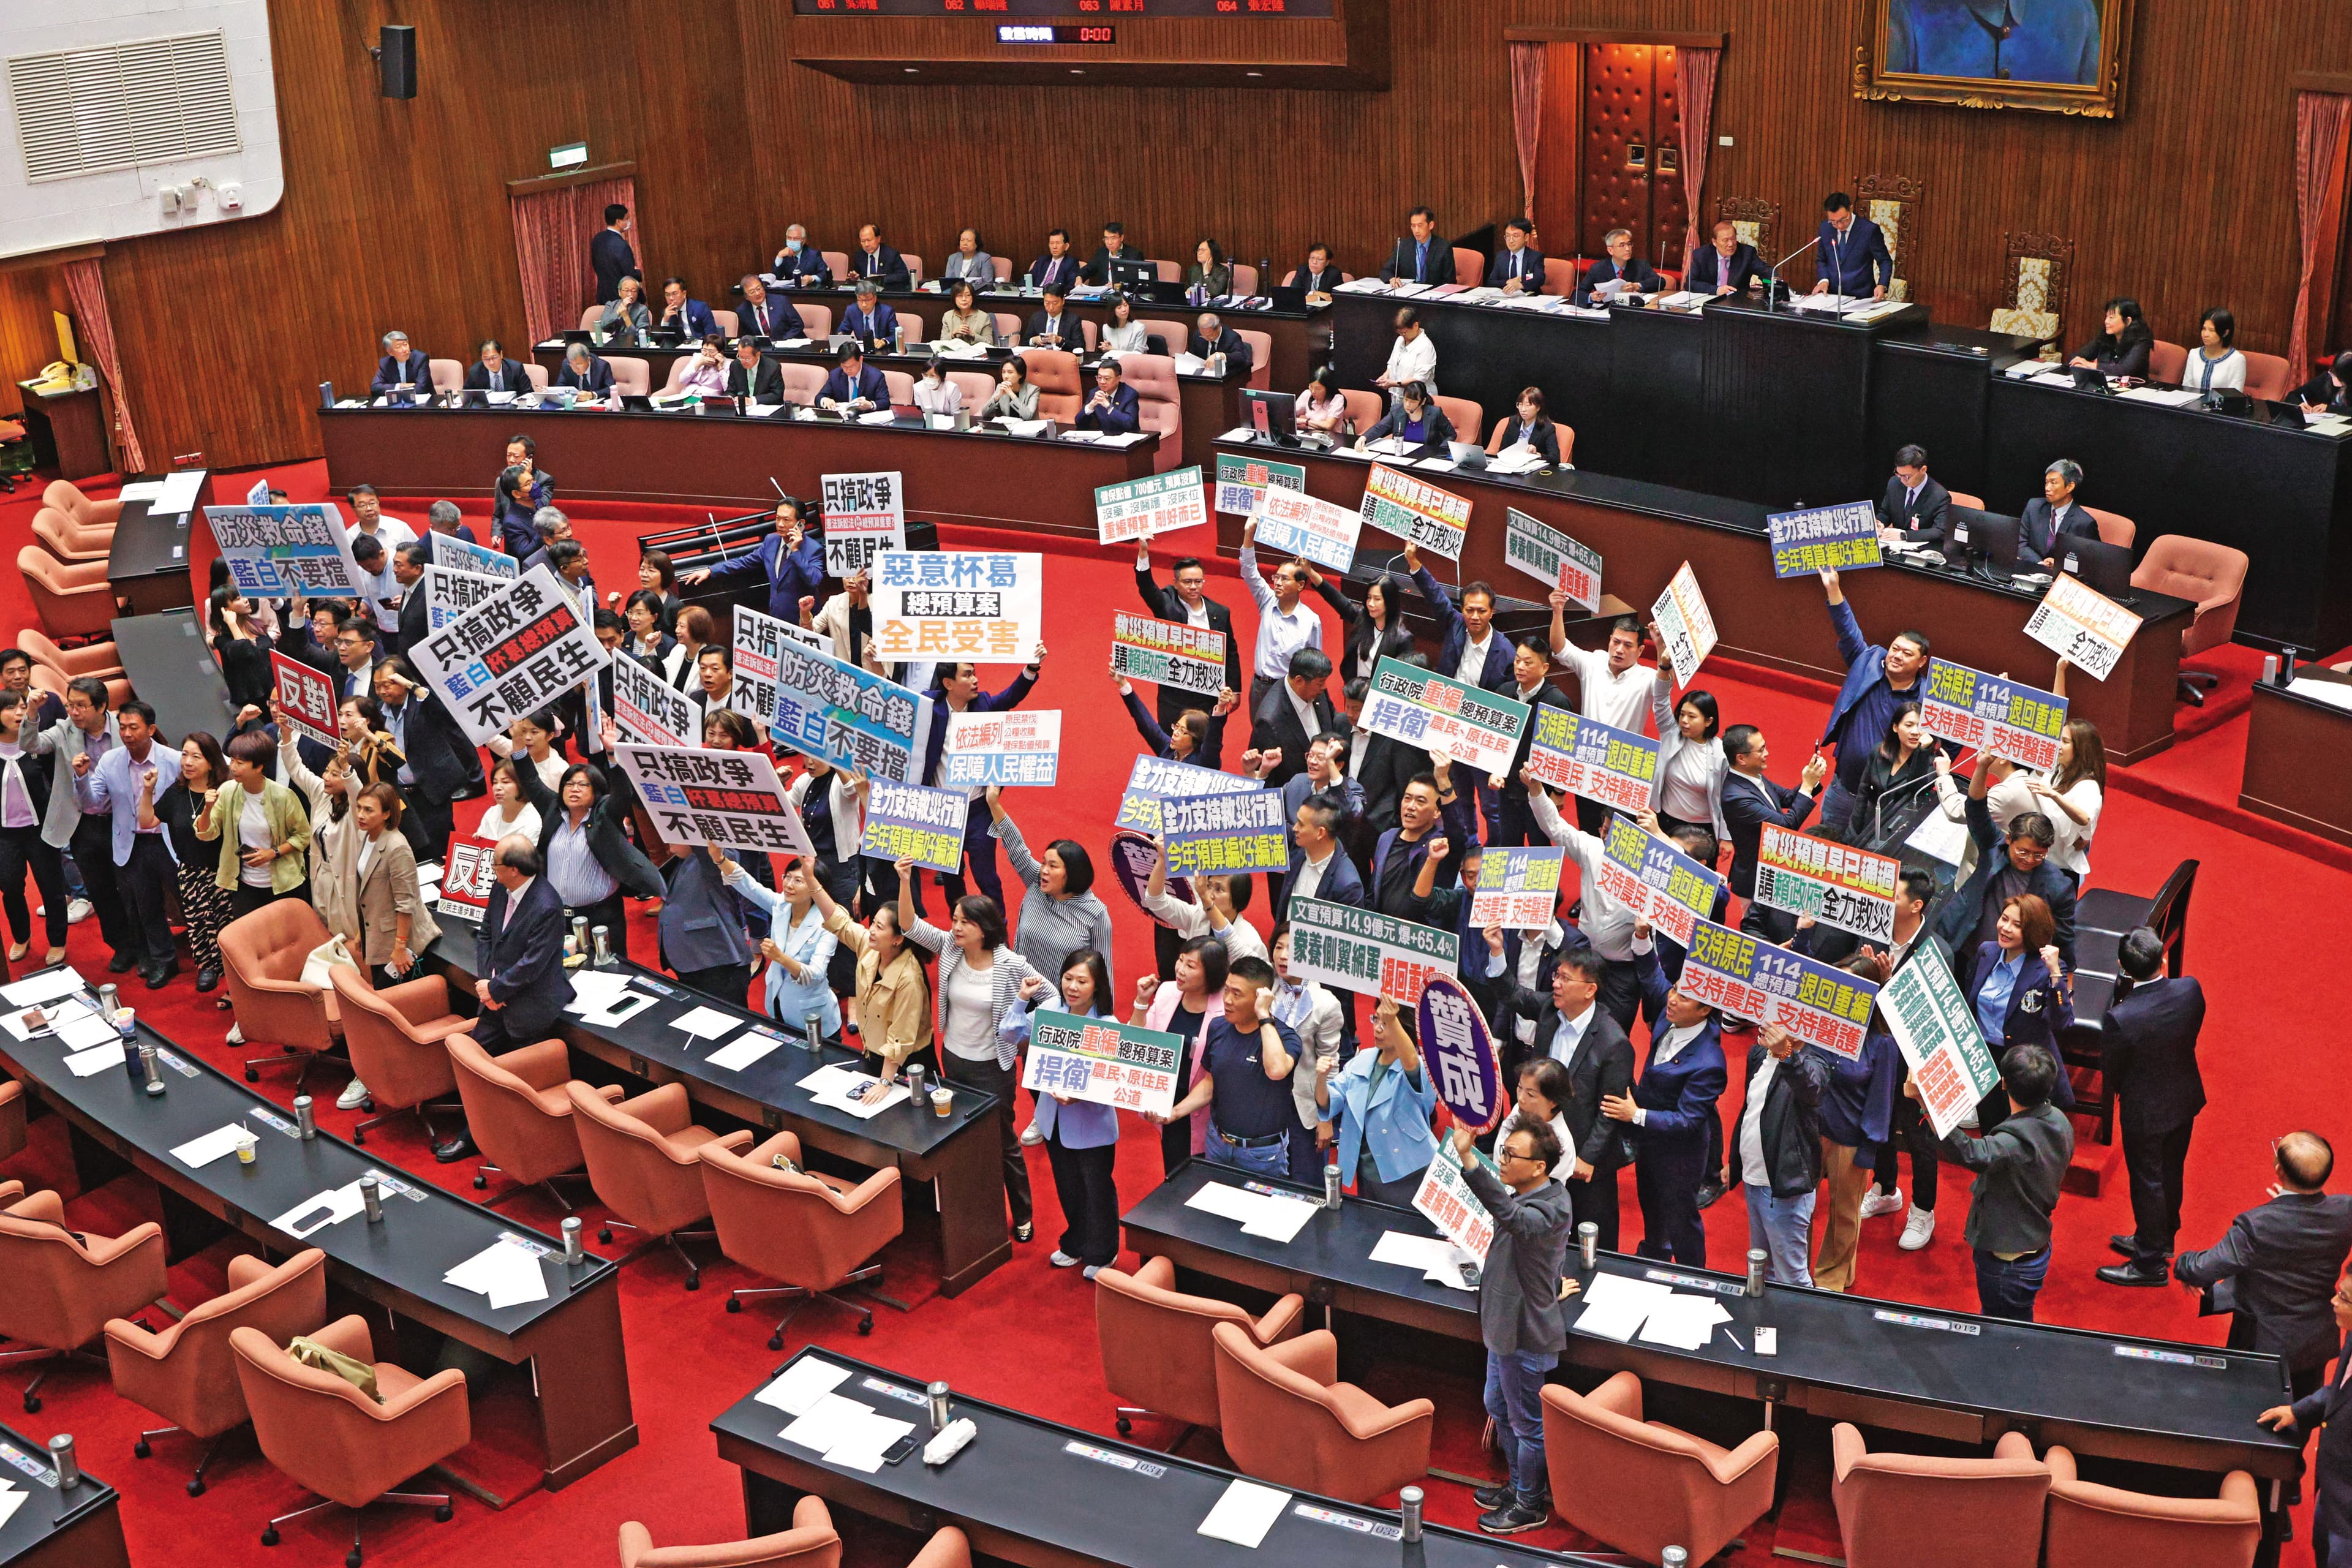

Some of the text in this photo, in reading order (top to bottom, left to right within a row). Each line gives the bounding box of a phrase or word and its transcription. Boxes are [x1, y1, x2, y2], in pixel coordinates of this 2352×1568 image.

[1080, 0, 1099, 11] 063
[1217, 0, 1237, 12] 064
[1080, 28, 1111, 42] 0:00
[825, 477, 892, 512] 只搞政爭
[1100, 470, 1198, 502] 健保點值 700億元 預算沒編
[1221, 487, 1254, 510] 捍衛
[1370, 466, 1470, 529] 救災預算早已通過
[1104, 503, 1202, 540] 重編預算 剛好而已
[1268, 496, 1312, 523] 依法編列
[1364, 494, 1463, 557] 請賴政府全力救災
[1770, 507, 1875, 543] 全力支持救災行動
[211, 514, 333, 548] 防災救命錢
[1258, 518, 1351, 570] 保障人民權益
[230, 557, 350, 589] 藍白不要擋
[883, 553, 1017, 588] 惡意杯葛
[1776, 538, 1880, 575] 今年預算編好編滿
[907, 592, 998, 616] 總預算案
[429, 580, 544, 672] 只搞政爭
[881, 620, 1019, 654] 全民受害
[1115, 613, 1223, 662] 救災預算早已通過
[467, 639, 598, 729] 不顧民生
[1115, 645, 1221, 692] 請賴政府全力救災
[277, 664, 331, 728] 反對
[615, 657, 690, 737] 只搞政爭
[735, 674, 776, 718] 不顧
[781, 647, 915, 738] 防災救命錢
[1379, 673, 1520, 734] 行政院重編總預算案
[1928, 662, 2064, 738] 支持原民 114 退回重編
[1973, 701, 2010, 722] 總預算
[956, 721, 1003, 750] 依法編列
[1005, 714, 1037, 724] 原民禁伐
[1370, 699, 1430, 737] 捍衛
[775, 697, 908, 781] 藍白不要擋
[1003, 740, 1052, 750] 健保點值預算
[1450, 742, 1479, 763] 公道
[1535, 709, 1657, 781] 支持原民 114 退回重編
[1576, 745, 1607, 766] 總預算
[1921, 704, 2057, 771] 支持農民 支持醫護
[631, 751, 754, 786] 只搞政爭
[949, 755, 1054, 783] 保障人民權益
[1531, 750, 1649, 810] 支持農民 支持醫護
[869, 782, 966, 829] 全力支持救災行動
[1164, 793, 1283, 834] 全力支持救災行動
[659, 811, 797, 850] 不顧民生
[865, 821, 960, 869] 今年預算編好編滿
[1167, 834, 1286, 872] 今年預算編好編滿
[1478, 851, 1558, 891] 支持原民 114 退回重編
[1606, 820, 1715, 918] 支持原民 114 退回重編
[1762, 827, 1897, 897] 救災預算早已通過
[1597, 862, 1648, 914] 支持農民
[1757, 867, 1891, 938] 請賴政府全力救災
[1295, 900, 1453, 957] 文宣預算14.9億元 爆+65.4%
[1471, 897, 1552, 925] 支持農民 支持醫護
[1294, 929, 1381, 981] 豢養側翼網軍
[1689, 924, 1873, 1024] 支持原民 114 退回重編
[1752, 971, 1798, 999] 總預算
[1681, 967, 1862, 1055] 支持農民 支持醫護
[1038, 1025, 1174, 1068] 行政院重編總預算案
[1427, 990, 1488, 1117] 贊成
[1033, 1054, 1091, 1091] 捍衛
[1091, 1061, 1169, 1092] 農民、原住民
[1114, 1087, 1142, 1106] 公道
[1419, 1180, 1493, 1259] 重編預算 剛好
[1954, 1324, 1977, 1332] 012
[1140, 1464, 1162, 1475] 031
[1376, 1526, 1400, 1538] 032
